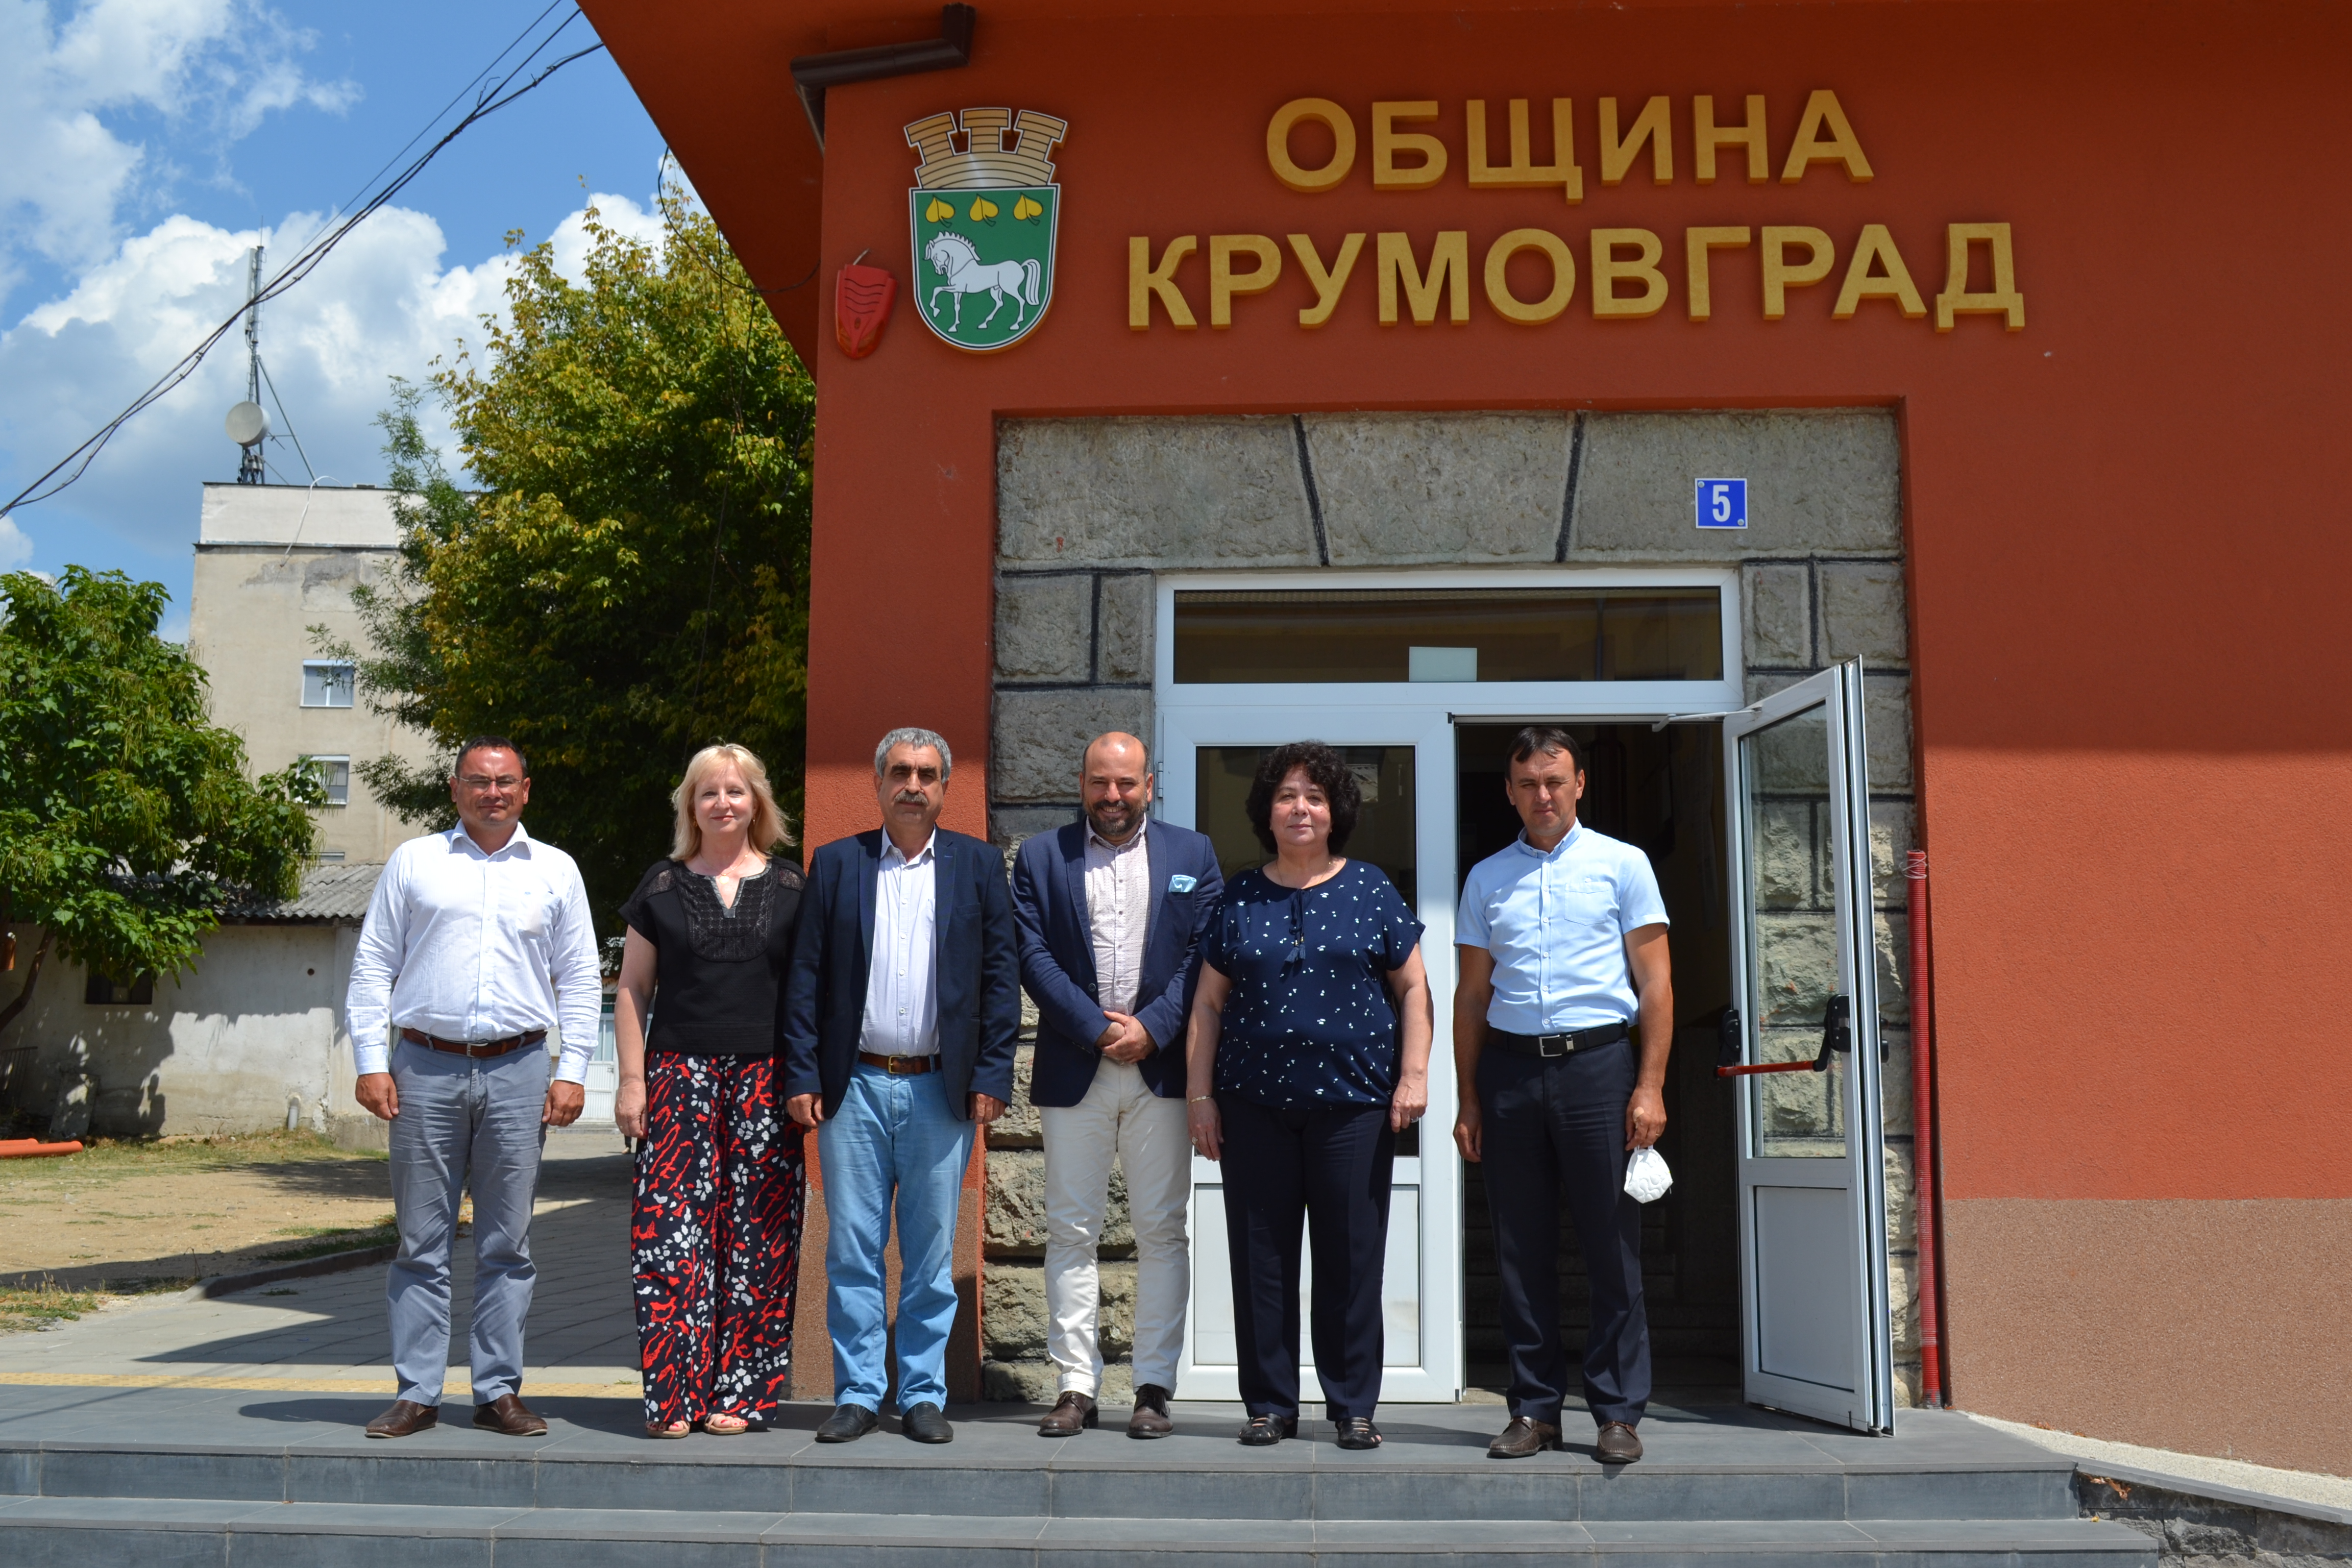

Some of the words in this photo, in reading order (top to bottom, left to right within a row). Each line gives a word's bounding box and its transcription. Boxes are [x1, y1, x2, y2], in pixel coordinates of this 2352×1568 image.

[1267, 90, 1874, 204] ОБЩИНА
[1129, 223, 2025, 332] КРУМОВГРАД
[1712, 485, 1731, 522] 5
